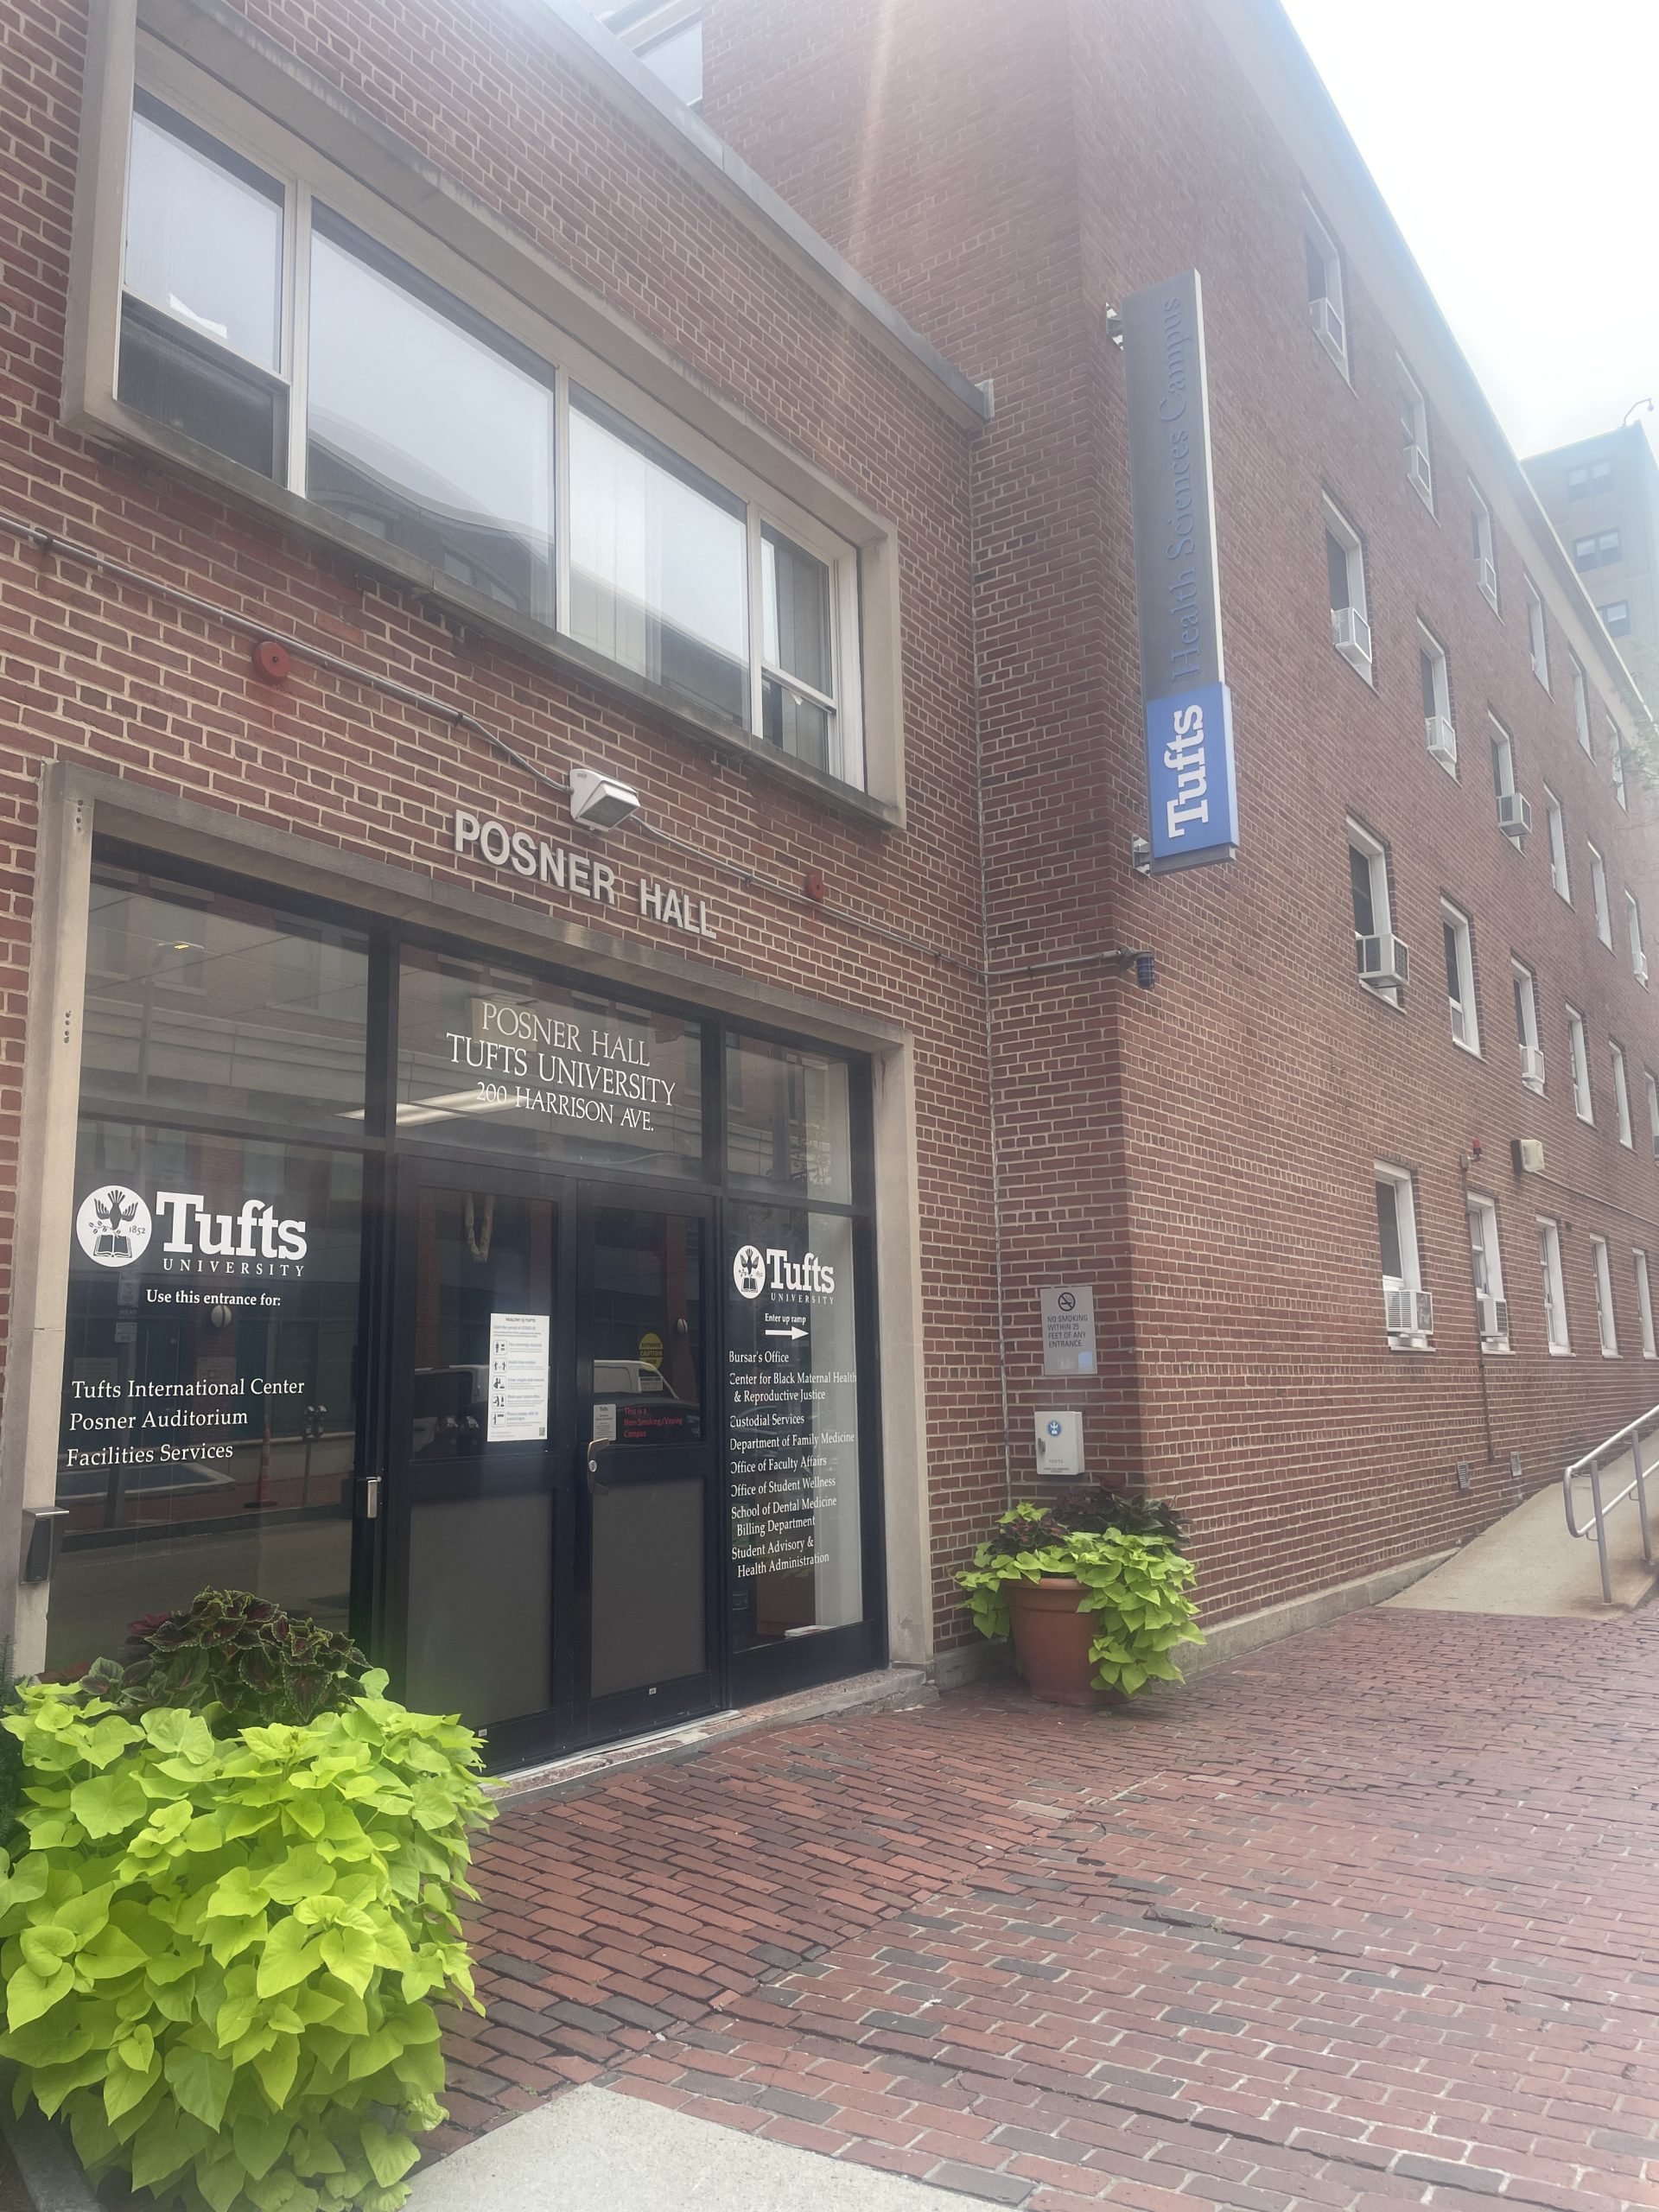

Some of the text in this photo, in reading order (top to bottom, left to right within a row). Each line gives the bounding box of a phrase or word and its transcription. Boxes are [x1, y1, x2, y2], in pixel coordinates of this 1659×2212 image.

[1160, 296, 1201, 681] Health Sciences Campus
[1163, 704, 1209, 839] Tufts
[454, 810, 717, 940] POSNER HALL
[481, 1001, 651, 1067] POSNER HALL
[446, 1033, 677, 1107] TUFTS UNIVERSITY
[476, 1081, 654, 1132] 200 HARRISON AVE.
[129, 1225, 146, 1236] 1852
[156, 1191, 308, 1261] Tufts
[162, 1258, 305, 1277] UNIVERSITY
[766, 1248, 836, 1294] Tufts
[146, 1289, 281, 1306] Use this entrance for:
[771, 1293, 835, 1306] UNIVERSITY
[765, 1313, 807, 1325] Enter up ramp
[1058, 1313, 1089, 1323] SMOKING
[1048, 1332, 1063, 1340] FEET
[1048, 1339, 1083, 1348] ENTRANCE
[728, 1351, 790, 1363] Bursar's Office
[72, 1377, 305, 1399] Tufts International Center
[729, 1371, 857, 1385] Center for Black Maternal Health
[734, 1389, 826, 1406] & Reproductive Justice
[69, 1409, 248, 1431] Posner Auditorium
[624, 1407, 638, 1415] This
[729, 1413, 804, 1427] Custodial Services
[623, 1430, 647, 1439] Campus
[729, 1431, 855, 1454] Department of Family Medicine
[66, 1444, 234, 1467] Facilities Services
[730, 1454, 827, 1474] Office of Faculty Affairs
[730, 1476, 836, 1497] Office of Student Wellness
[731, 1496, 837, 1520] School of Dental Medicine
[736, 1515, 816, 1538] Billing Department
[731, 1535, 815, 1560] Student Advisory &
[737, 1552, 830, 1579] Health Administration
